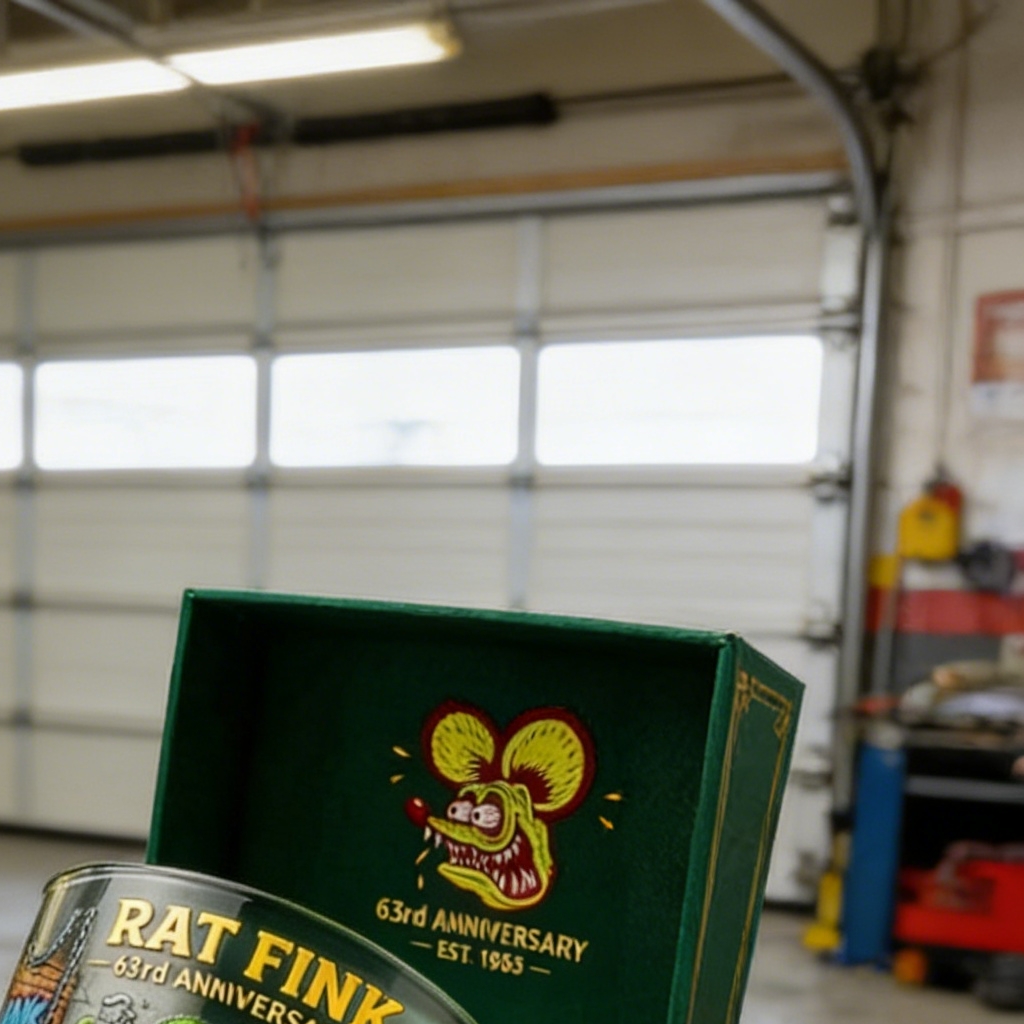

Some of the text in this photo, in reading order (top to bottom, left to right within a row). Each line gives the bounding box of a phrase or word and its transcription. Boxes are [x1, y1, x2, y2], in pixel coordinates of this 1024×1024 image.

[376, 897, 426, 928] 63rd
[107, 898, 242, 964] RAT
[437, 939, 473, 965] EST.
[113, 955, 170, 985] 63rd
